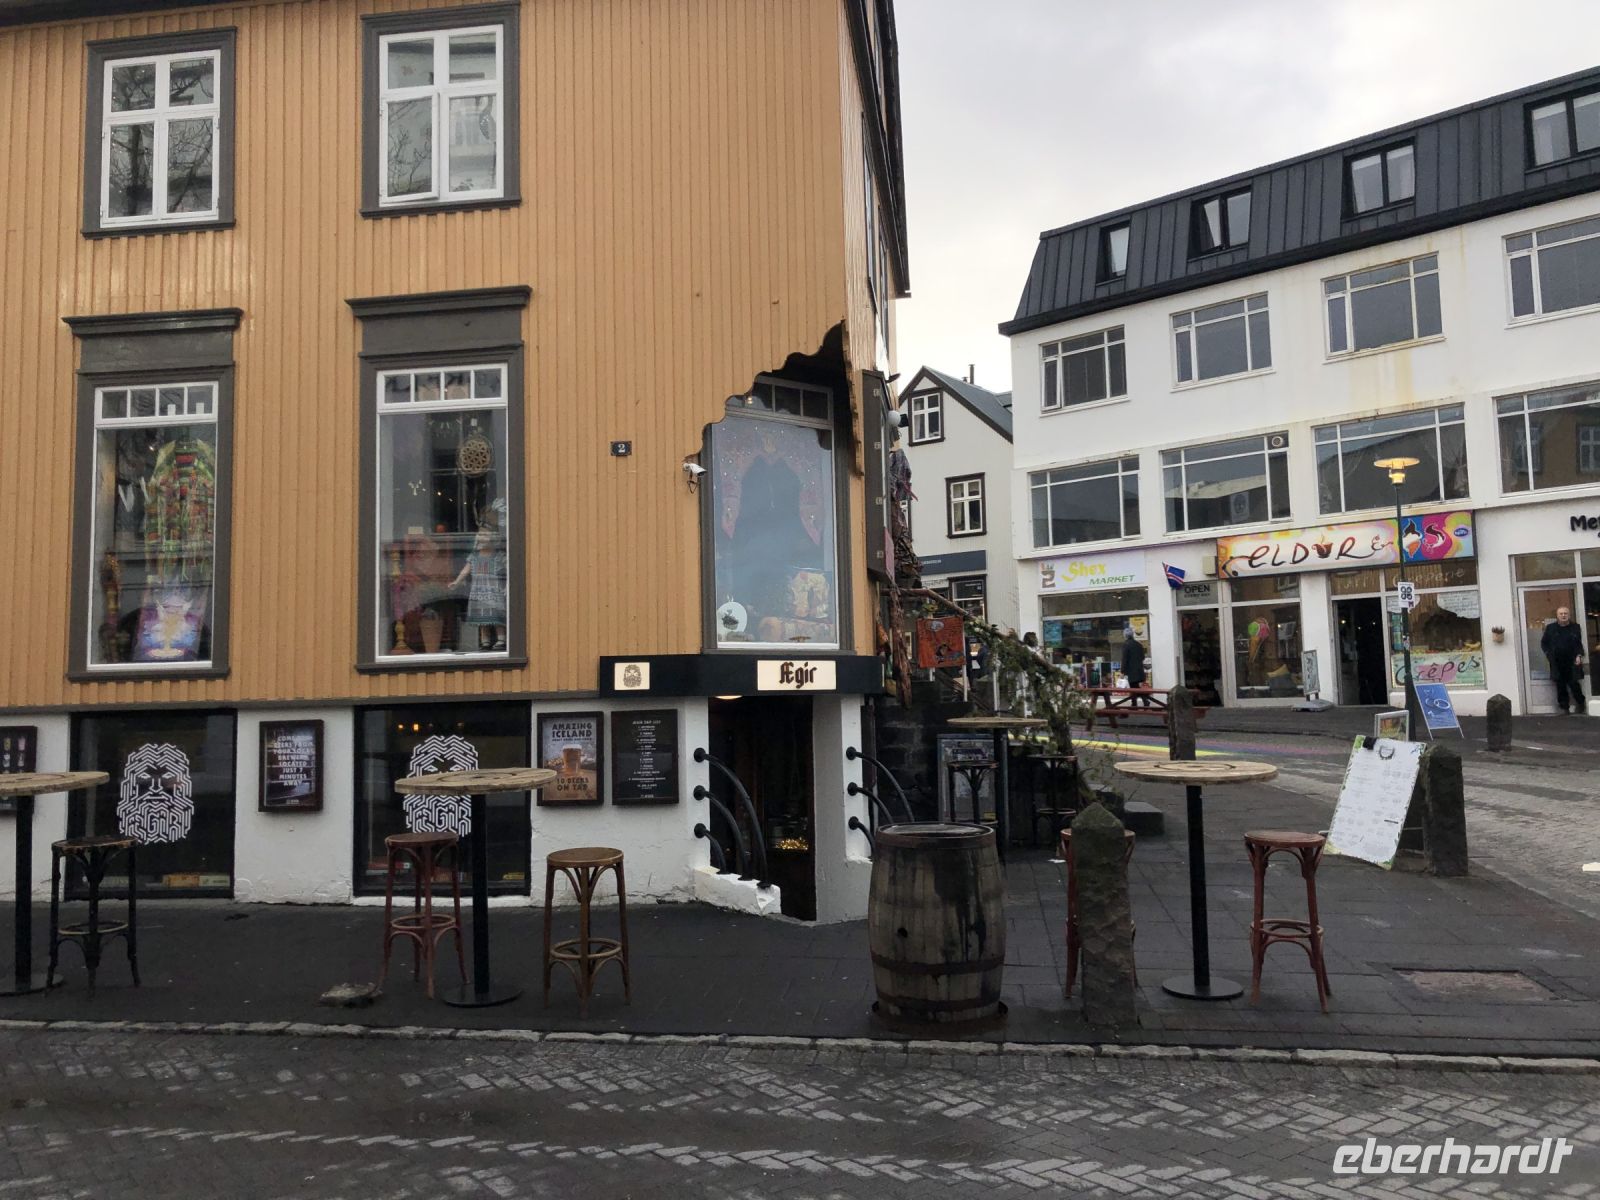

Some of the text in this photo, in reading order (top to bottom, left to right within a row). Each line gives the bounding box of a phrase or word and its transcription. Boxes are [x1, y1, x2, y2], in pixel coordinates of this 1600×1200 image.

[617, 443, 626, 453] 2
[1061, 561, 1107, 582] Shex
[1089, 574, 1136, 586] MARKET
[1184, 584, 1211, 594] OPEN
[779, 661, 818, 689] Ægir
[552, 722, 593, 730] AMAZING
[552, 729, 593, 738] ICELAND
[556, 784, 570, 792] ON
